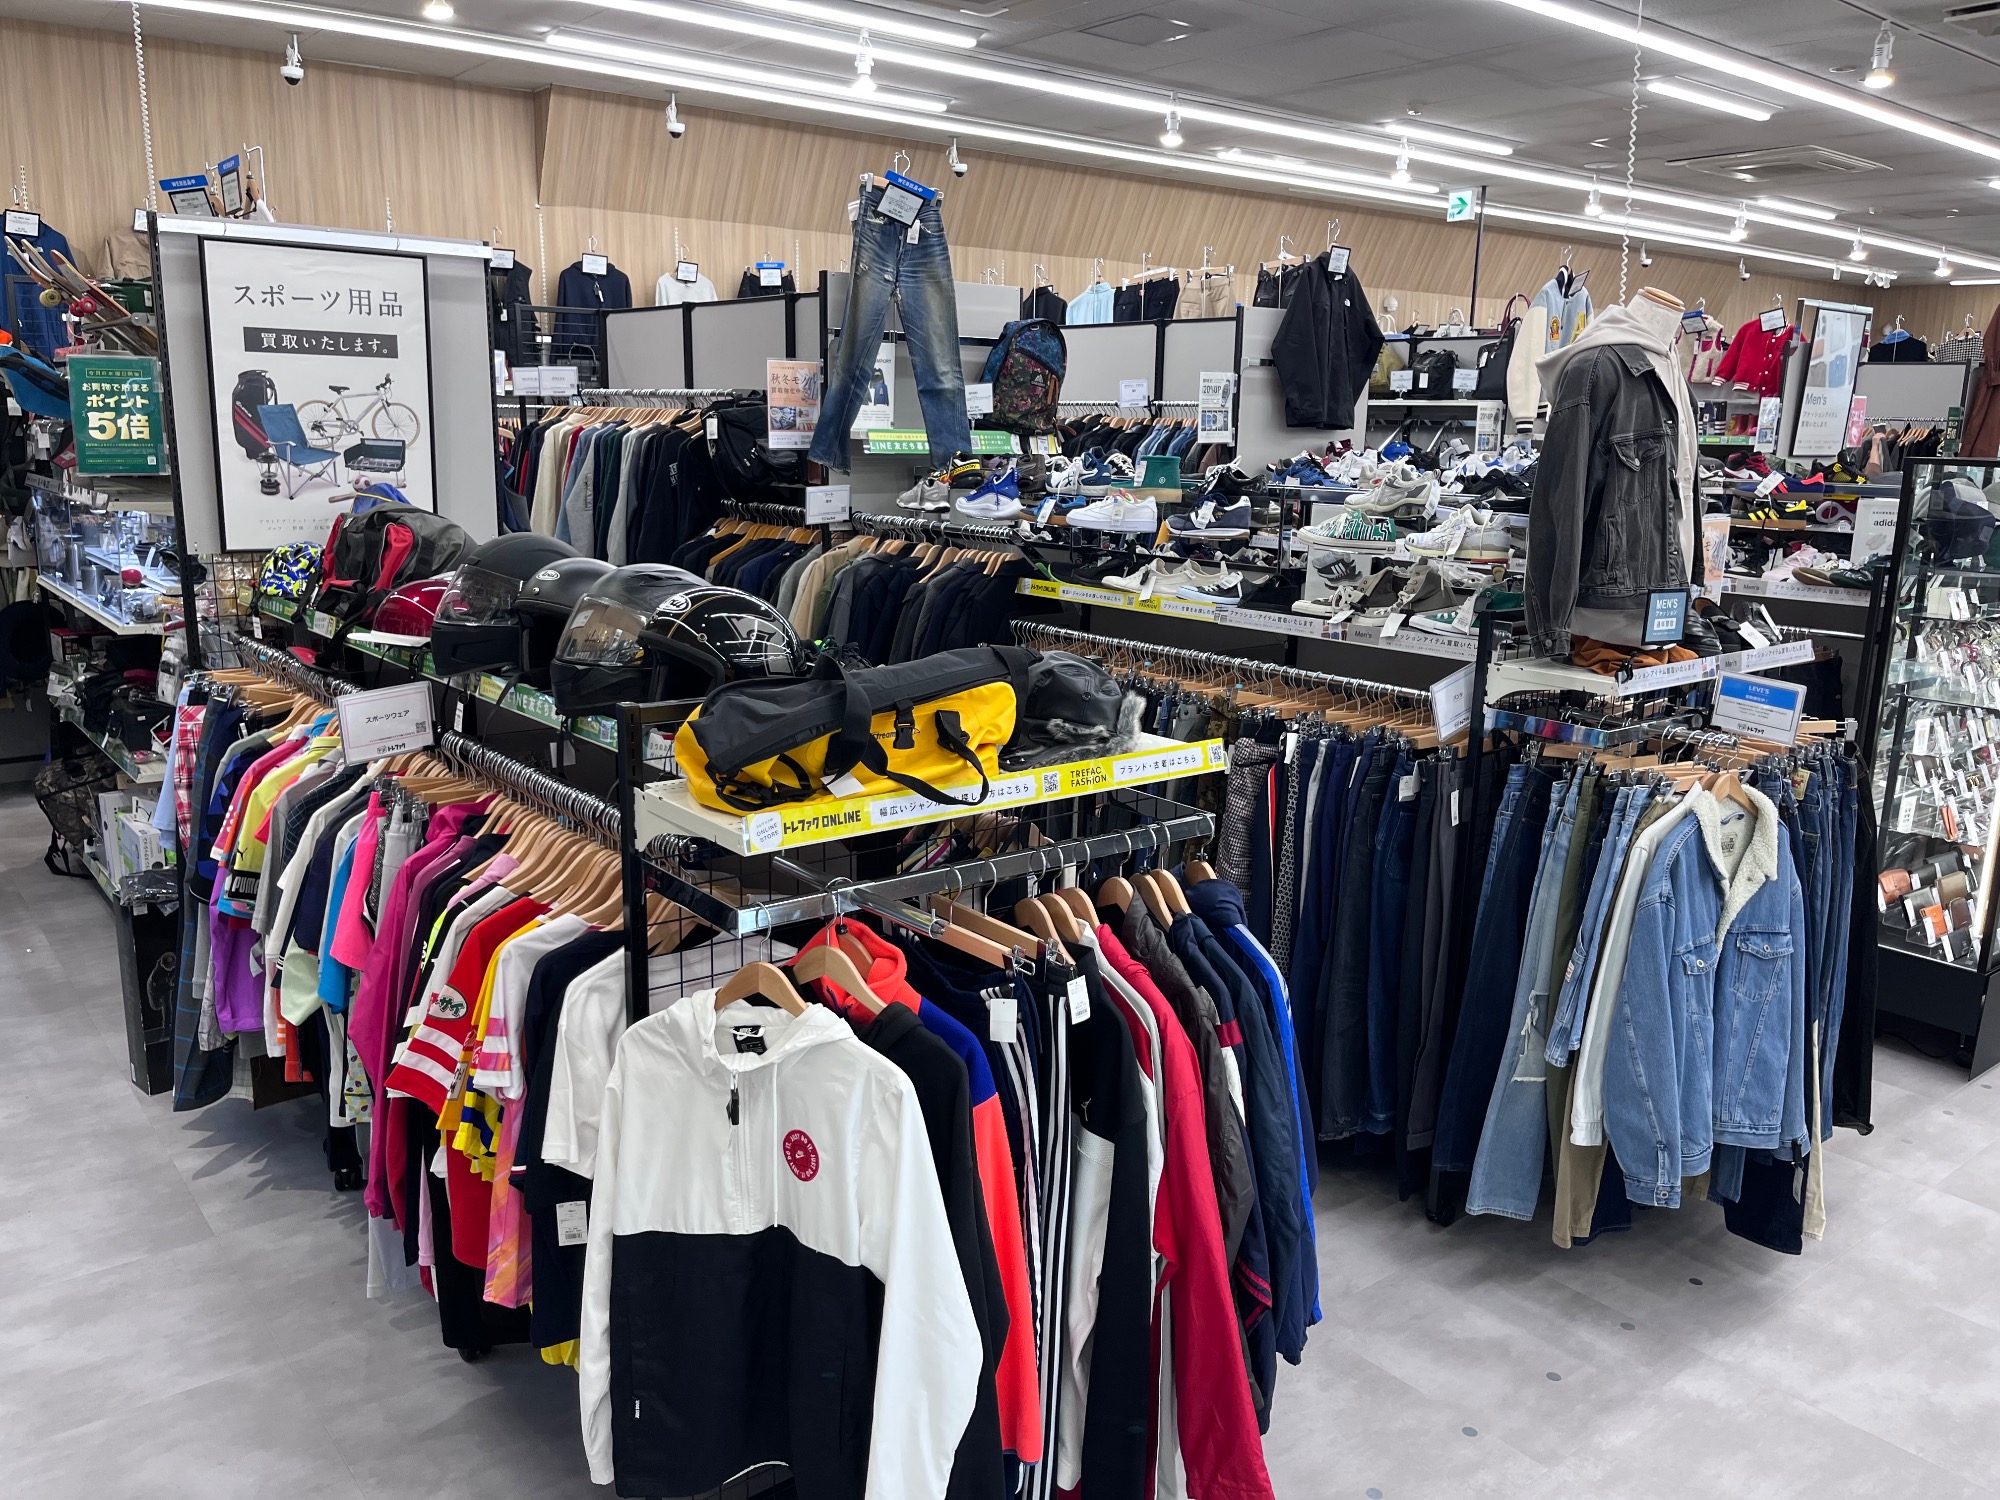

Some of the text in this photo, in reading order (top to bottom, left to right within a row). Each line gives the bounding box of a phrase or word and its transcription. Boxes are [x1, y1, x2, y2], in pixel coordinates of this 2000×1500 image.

[234, 284, 403, 317] スポーツ用品
[260, 332, 388, 354] 買取いたします。
[82, 382, 150, 392] お買物で貯まる
[86, 394, 150, 408] ポイント
[1805, 393, 1827, 405] Men's
[87, 411, 150, 440] 5倍
[1656, 598, 1678, 609] MEN'S
[1354, 630, 1373, 639] Men's
[1748, 685, 1770, 695] LEVI'S
[365, 709, 410, 724] スポーツウェア
[387, 742, 406, 752] トレファク
[1120, 754, 1196, 775] ブランド・古着はこちら
[1070, 766, 1102, 779] TREFAC
[1071, 774, 1107, 788] FASHION
[783, 809, 862, 834] トレファク ONLINE
[756, 822, 778, 837] ONLINE
[759, 830, 779, 843] STORE
